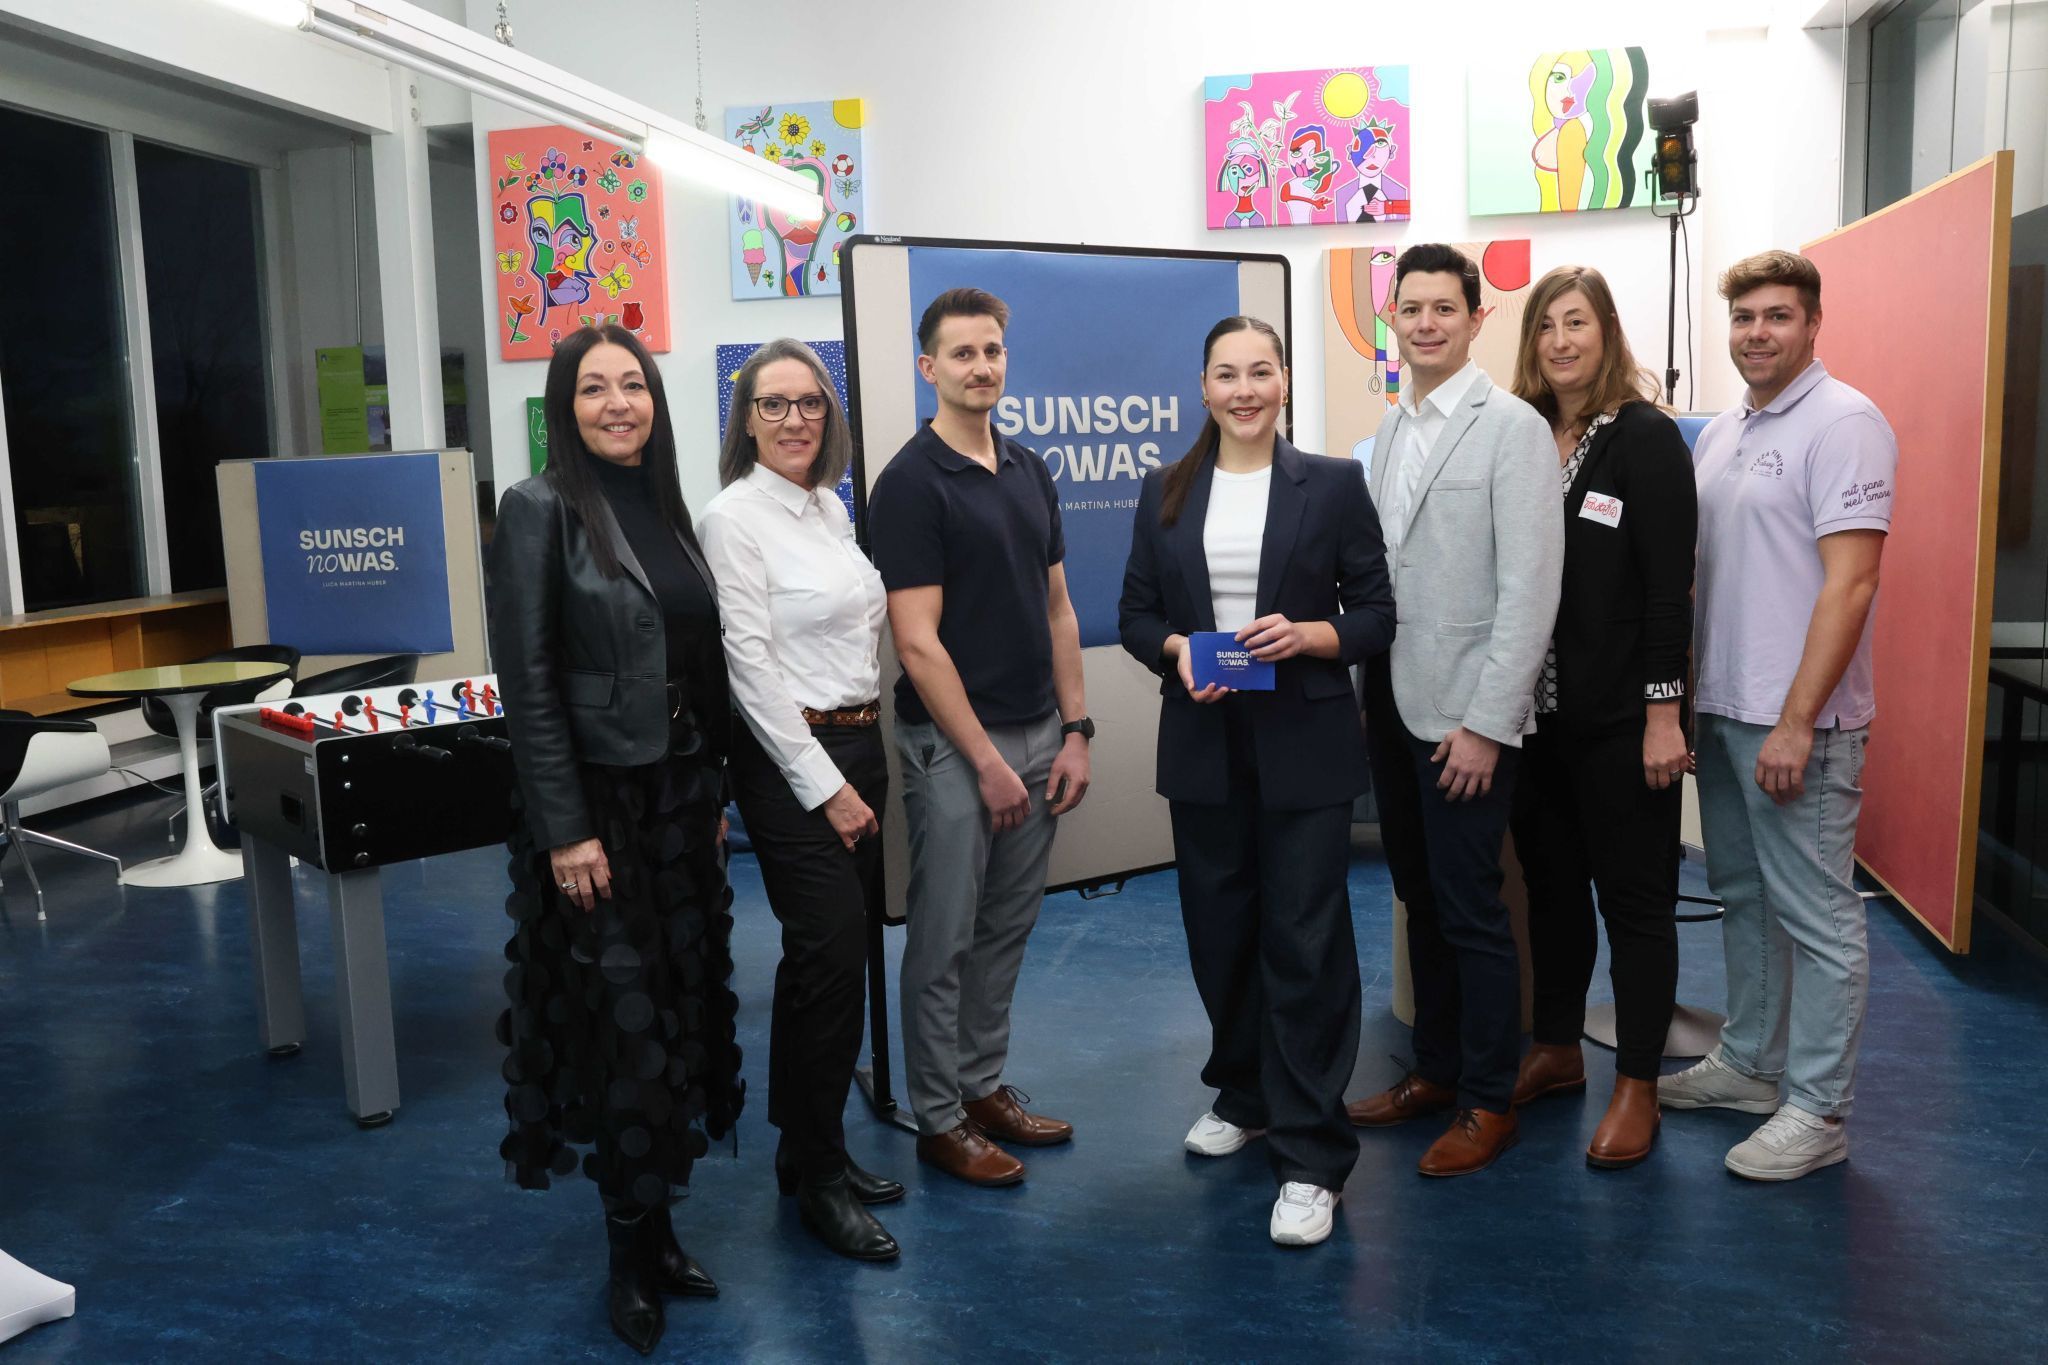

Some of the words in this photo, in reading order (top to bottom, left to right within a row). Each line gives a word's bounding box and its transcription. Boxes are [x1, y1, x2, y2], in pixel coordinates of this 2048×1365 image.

[996, 395, 1179, 436] SUNSCH
[1027, 442, 1162, 482] oWAS
[1841, 483, 1860, 500] mit
[1843, 493, 1863, 509] viel
[1065, 501, 1110, 511] MARTINA
[1113, 499, 1139, 509] HUBE
[299, 526, 404, 550] SUNSCH
[306, 550, 399, 573] noWAS.
[1216, 651, 1252, 659] SUNSCH
